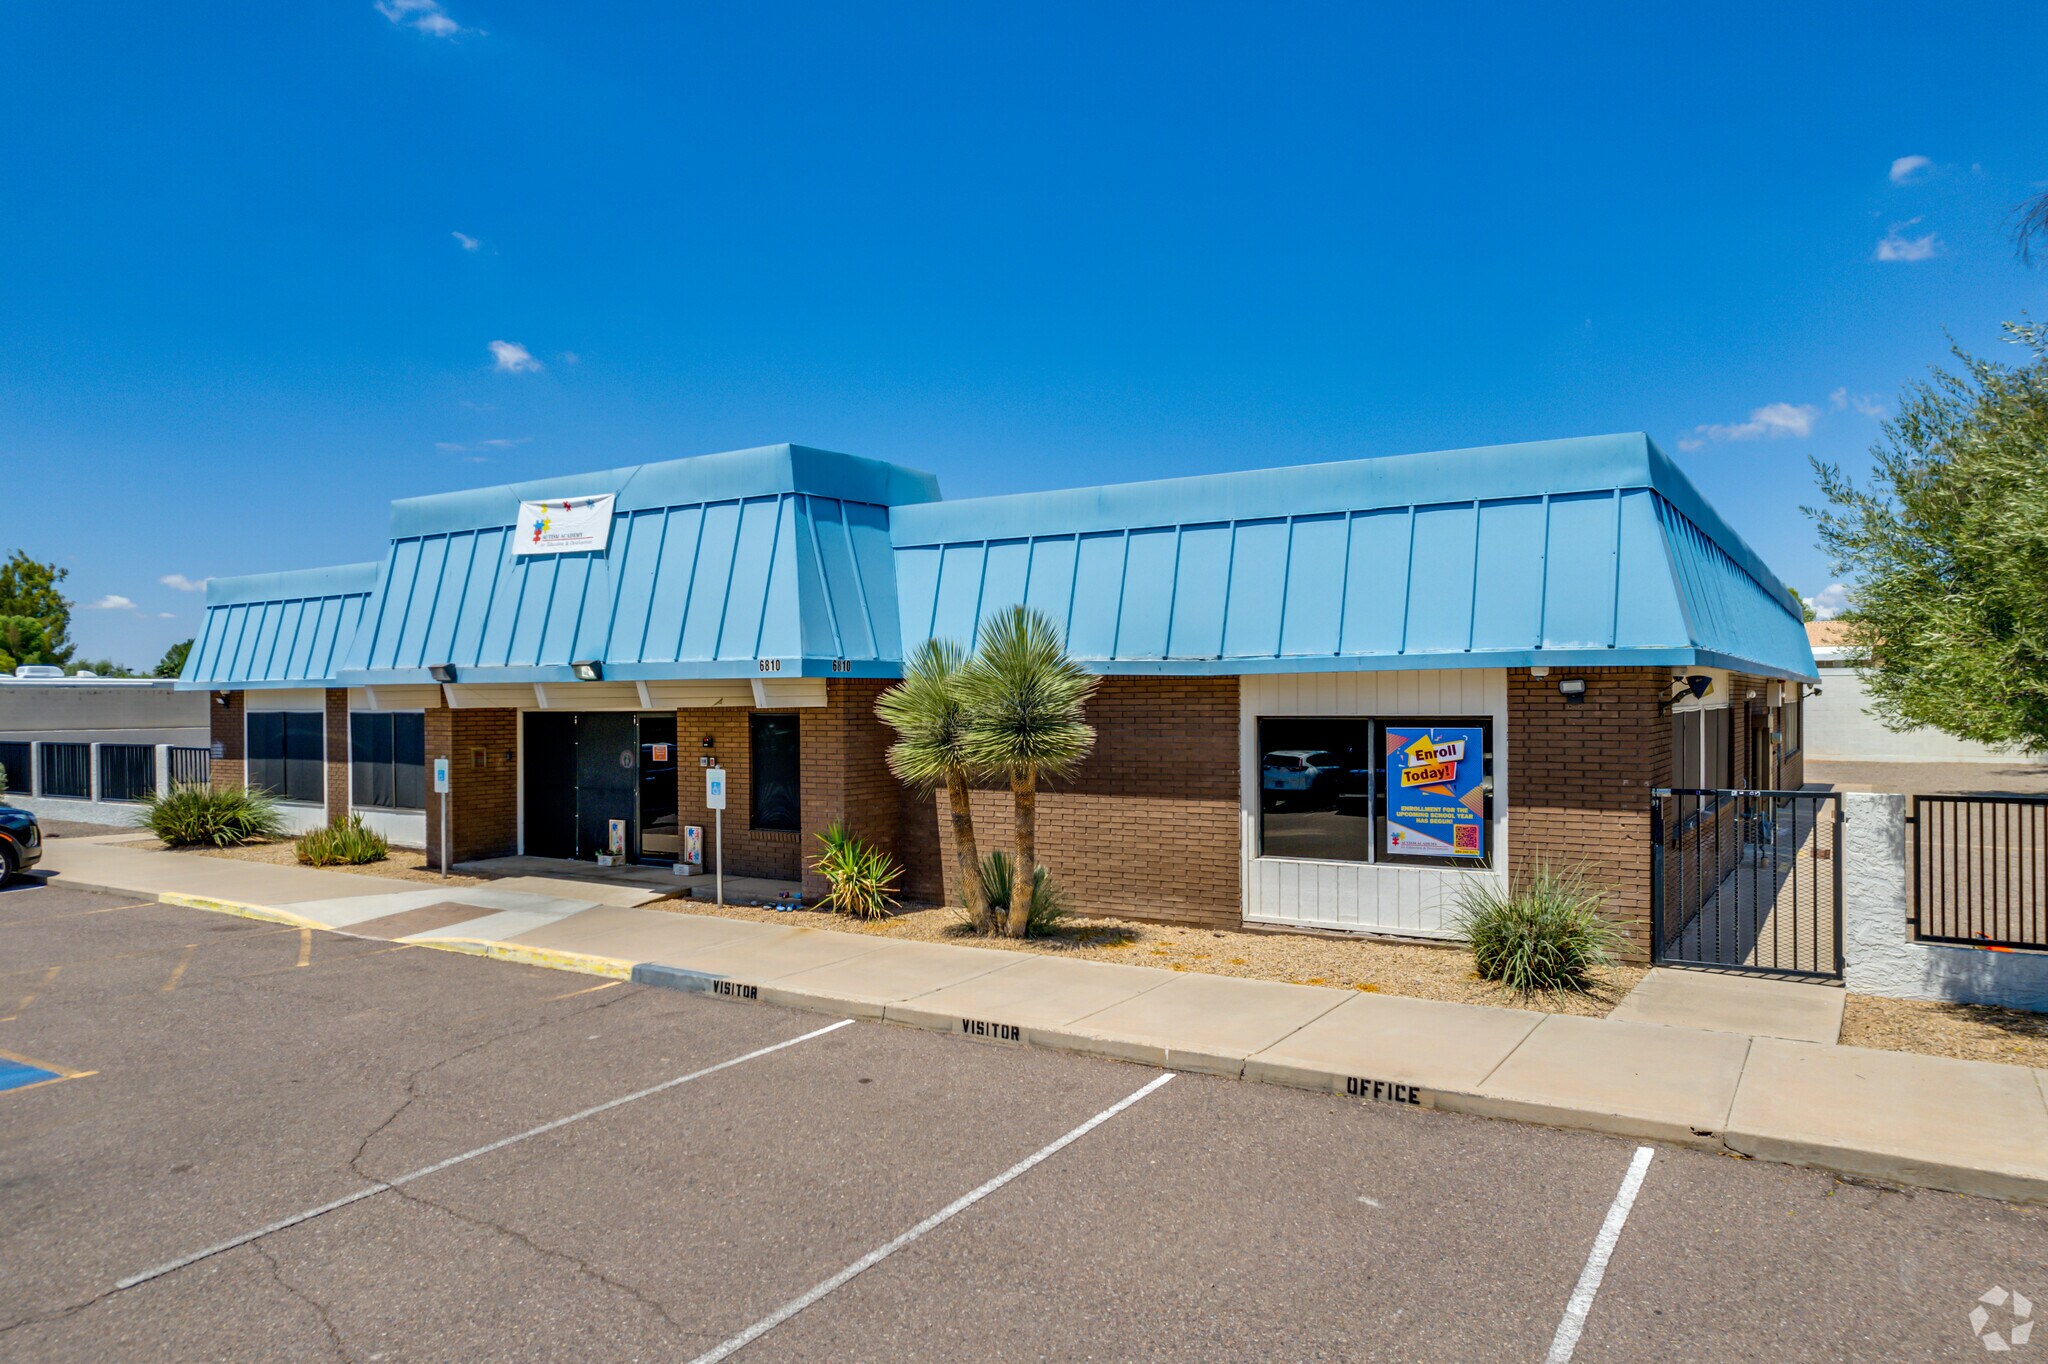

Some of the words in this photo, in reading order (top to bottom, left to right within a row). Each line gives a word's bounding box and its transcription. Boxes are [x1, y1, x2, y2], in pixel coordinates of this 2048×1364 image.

[759, 659, 781, 672] 6810
[832, 660, 851, 672] 6810
[1415, 744, 1457, 762] Enroll
[1404, 765, 1450, 782] Today!
[713, 980, 758, 1000] VISITOR
[962, 1018, 1020, 1041] VISITOR
[1347, 1076, 1420, 1105] OFFICE
